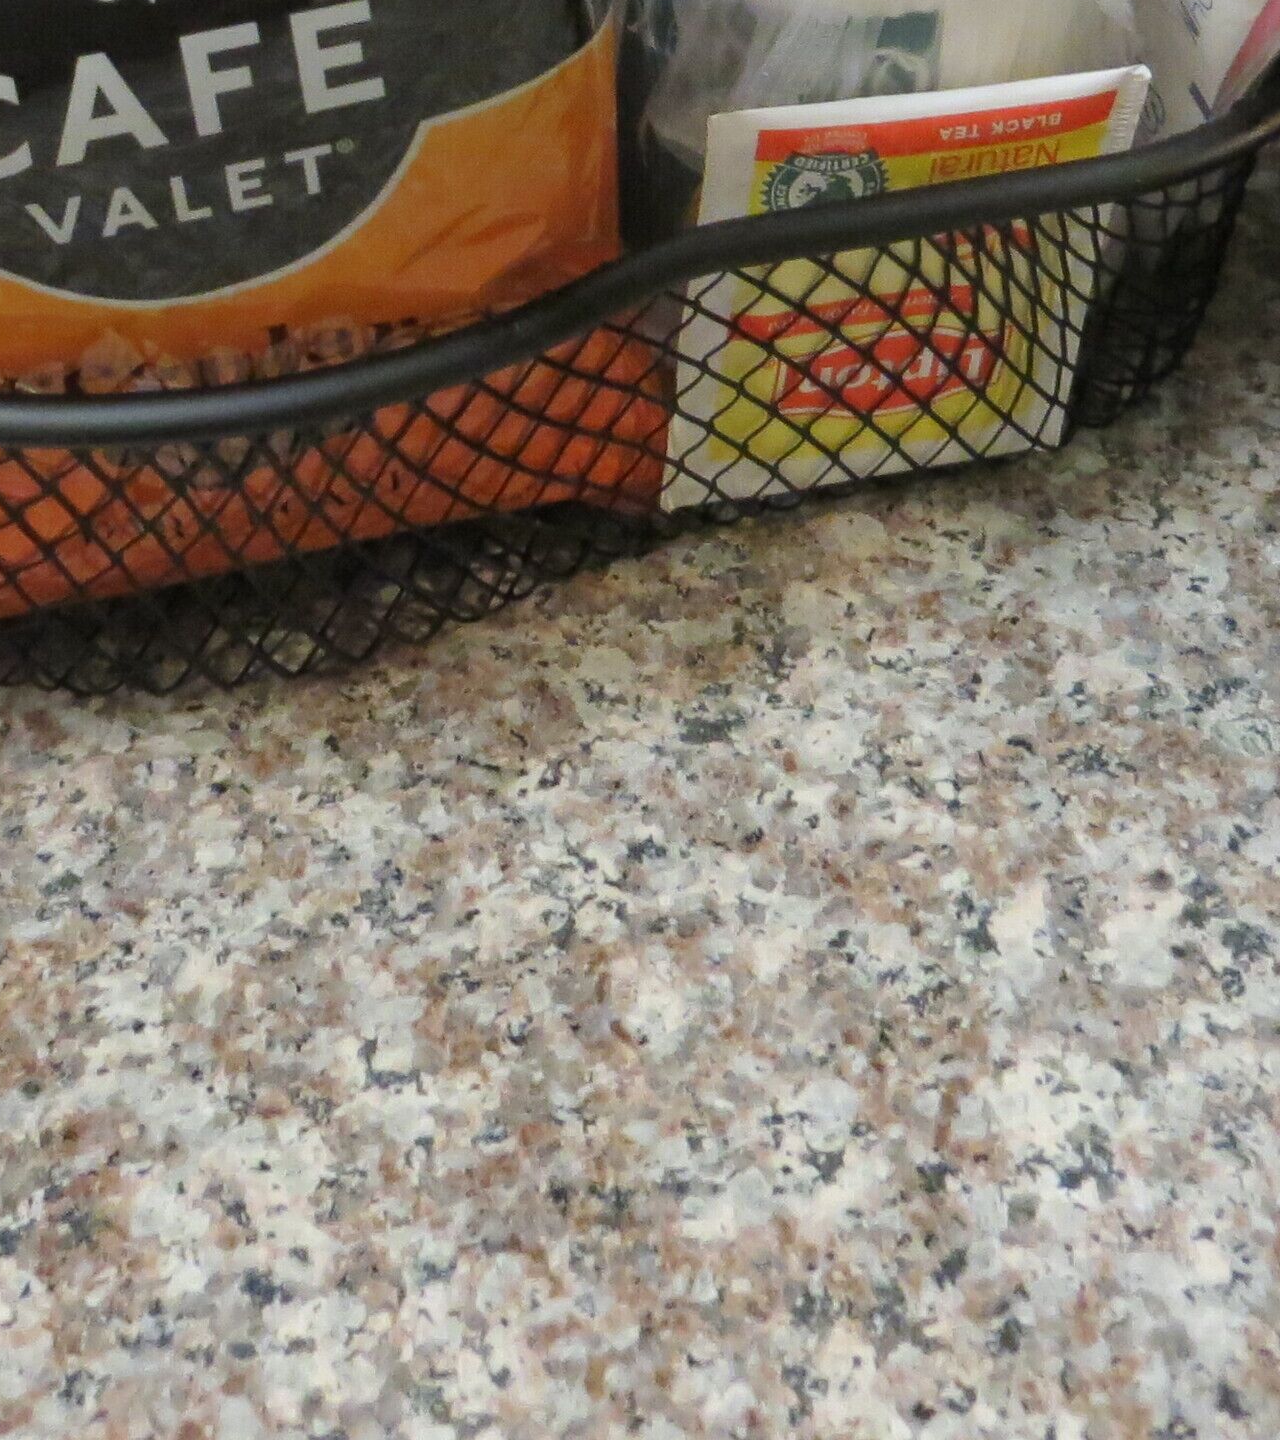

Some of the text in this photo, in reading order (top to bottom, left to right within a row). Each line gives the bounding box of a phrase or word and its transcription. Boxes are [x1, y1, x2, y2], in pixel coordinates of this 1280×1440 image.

[939, 111, 1064, 140] BLACK TEA
[790, 150, 876, 175] CERTIFIED
[928, 139, 1063, 184] Natural
[24, 142, 332, 246] VALET
